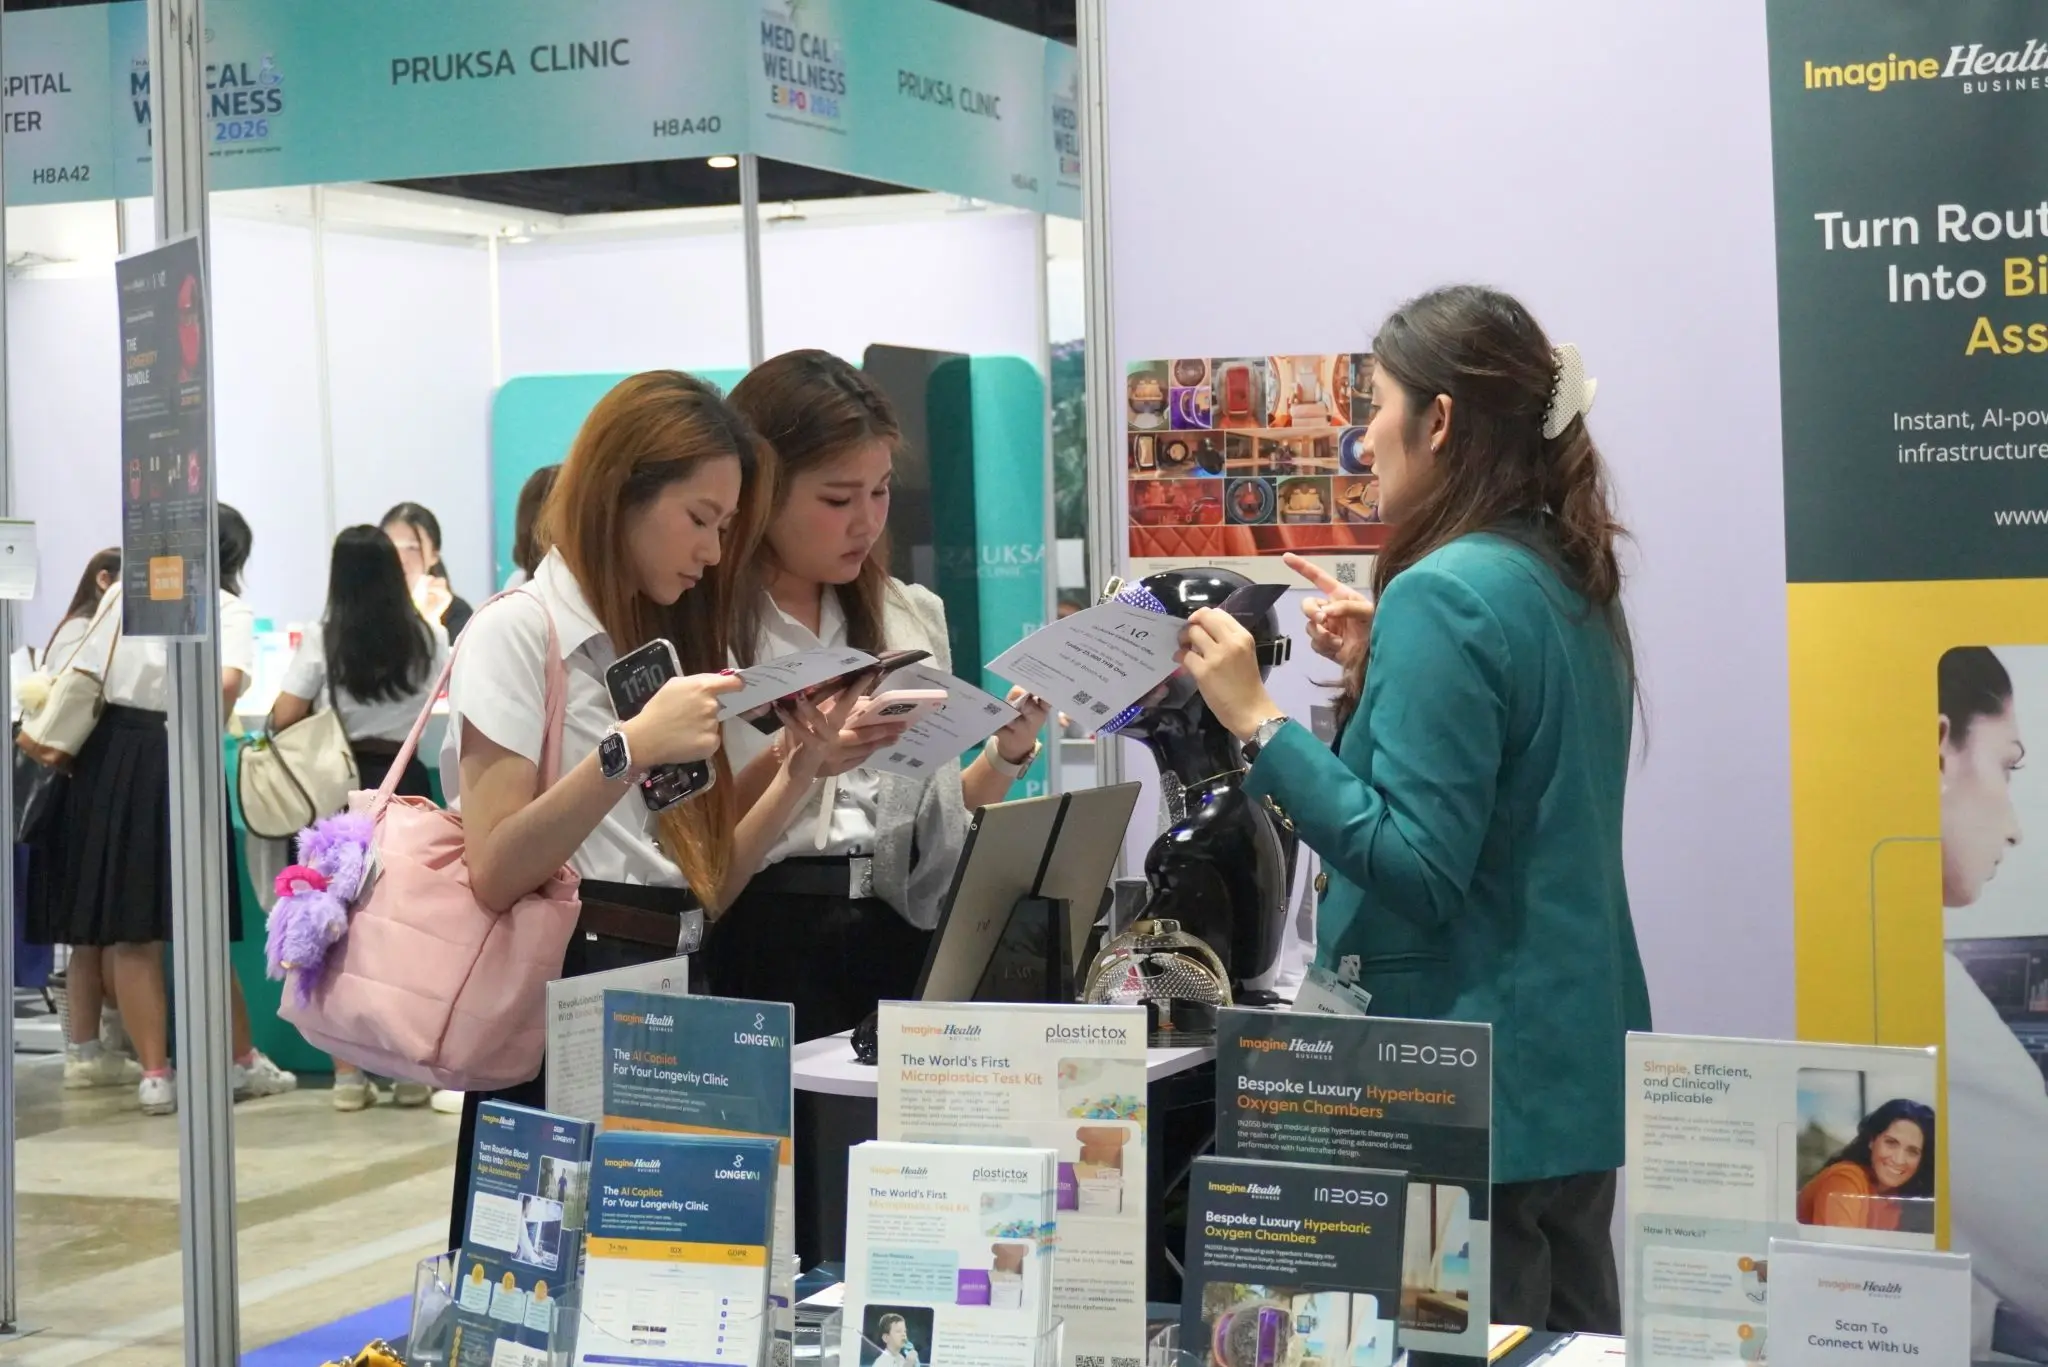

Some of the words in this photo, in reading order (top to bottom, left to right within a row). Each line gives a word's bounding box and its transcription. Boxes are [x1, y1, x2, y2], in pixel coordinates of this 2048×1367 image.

[391, 49, 516, 85] PRUKSA
[530, 38, 630, 73] CLINIC
[1805, 53, 1939, 91] Imagine
[1941, 38, 2048, 78] Healt
[763, 52, 846, 95] WELLNESS
[898, 69, 954, 109] PRUKSA
[960, 87, 1001, 121] CLINIC
[216, 119, 268, 141] 2026
[653, 116, 721, 137] H8A40
[33, 166, 90, 184] H8A42
[1814, 211, 1919, 250] Turn
[1889, 264, 1987, 302] Into
[2004, 254, 2048, 296] Bi
[1965, 316, 2048, 356] Ass
[1893, 411, 1975, 431] Instant,
[1898, 442, 2048, 463] infrastructure
[620, 663, 665, 704] 11:10
[613, 1011, 644, 1025] Imagine
[644, 1013, 674, 1027] Health
[901, 1025, 942, 1038] Imagine
[943, 1024, 982, 1036] Health
[1046, 1024, 1127, 1043] plastictox
[1239, 1036, 1288, 1053] Imagine
[1288, 1038, 1334, 1053] Health
[613, 1048, 630, 1060] The
[632, 1050, 642, 1062] AI
[644, 1051, 678, 1066] Copilot
[901, 1054, 925, 1066] The
[929, 1055, 977, 1068] World's
[981, 1056, 1010, 1068] First
[1296, 1053, 1333, 1061] BUSINESS
[613, 1063, 628, 1076] For
[630, 1064, 652, 1079] Your
[653, 1068, 700, 1086] Longevity
[702, 1072, 729, 1087] Clinic
[901, 1070, 988, 1086] Microplastics
[992, 1072, 1021, 1085] Test
[1024, 1073, 1043, 1086] Kit
[1694, 1064, 1752, 1080] Efficient,
[1237, 1075, 1304, 1096] Bespoke
[1309, 1081, 1362, 1100] Luxury
[1366, 1085, 1456, 1105] Hyperbaric
[1643, 1076, 1669, 1088] and
[1672, 1077, 1731, 1094] Clinically
[1237, 1094, 1299, 1115] Oxygen
[1303, 1100, 1384, 1119] Chambers
[1643, 1090, 1713, 1105] Applicable
[1237, 1130, 1249, 1138] the
[1331, 1126, 1367, 1136] hyperbaric
[1367, 1130, 1394, 1140] therapy
[480, 1141, 491, 1151] Turn
[492, 1143, 512, 1156] Routine
[513, 1148, 529, 1160] Blood
[604, 1158, 634, 1170] Imagine
[633, 1158, 661, 1169] Health
[900, 1165, 928, 1176] Health
[973, 1166, 1028, 1181] plastictox
[603, 1186, 619, 1196] The
[621, 1187, 631, 1197] AI
[632, 1187, 663, 1199] Copilot
[869, 1187, 887, 1197] The
[889, 1189, 924, 1199] World's
[926, 1190, 948, 1200] First
[1208, 1182, 1247, 1195] Imagine
[1246, 1183, 1282, 1196] Health
[602, 1197, 616, 1207] For
[618, 1198, 639, 1208] Your
[640, 1199, 683, 1212] Longevity
[684, 1201, 709, 1212] Clinic
[1205, 1210, 1257, 1226] Bespoke
[1260, 1215, 1301, 1232] Luxury
[1303, 1218, 1371, 1235] Hyperbaric
[1643, 1226, 1663, 1235] How
[1204, 1225, 1252, 1241] Oxygen
[1255, 1229, 1317, 1245] Chambers
[1817, 1278, 1862, 1293] Imagine
[1862, 1280, 1902, 1295] Health
[1835, 1319, 1867, 1334] Scan
[1871, 1322, 1888, 1335] To
[1808, 1334, 1864, 1350] Connect
[1867, 1339, 1899, 1354] With
[1903, 1343, 1919, 1355] Us
